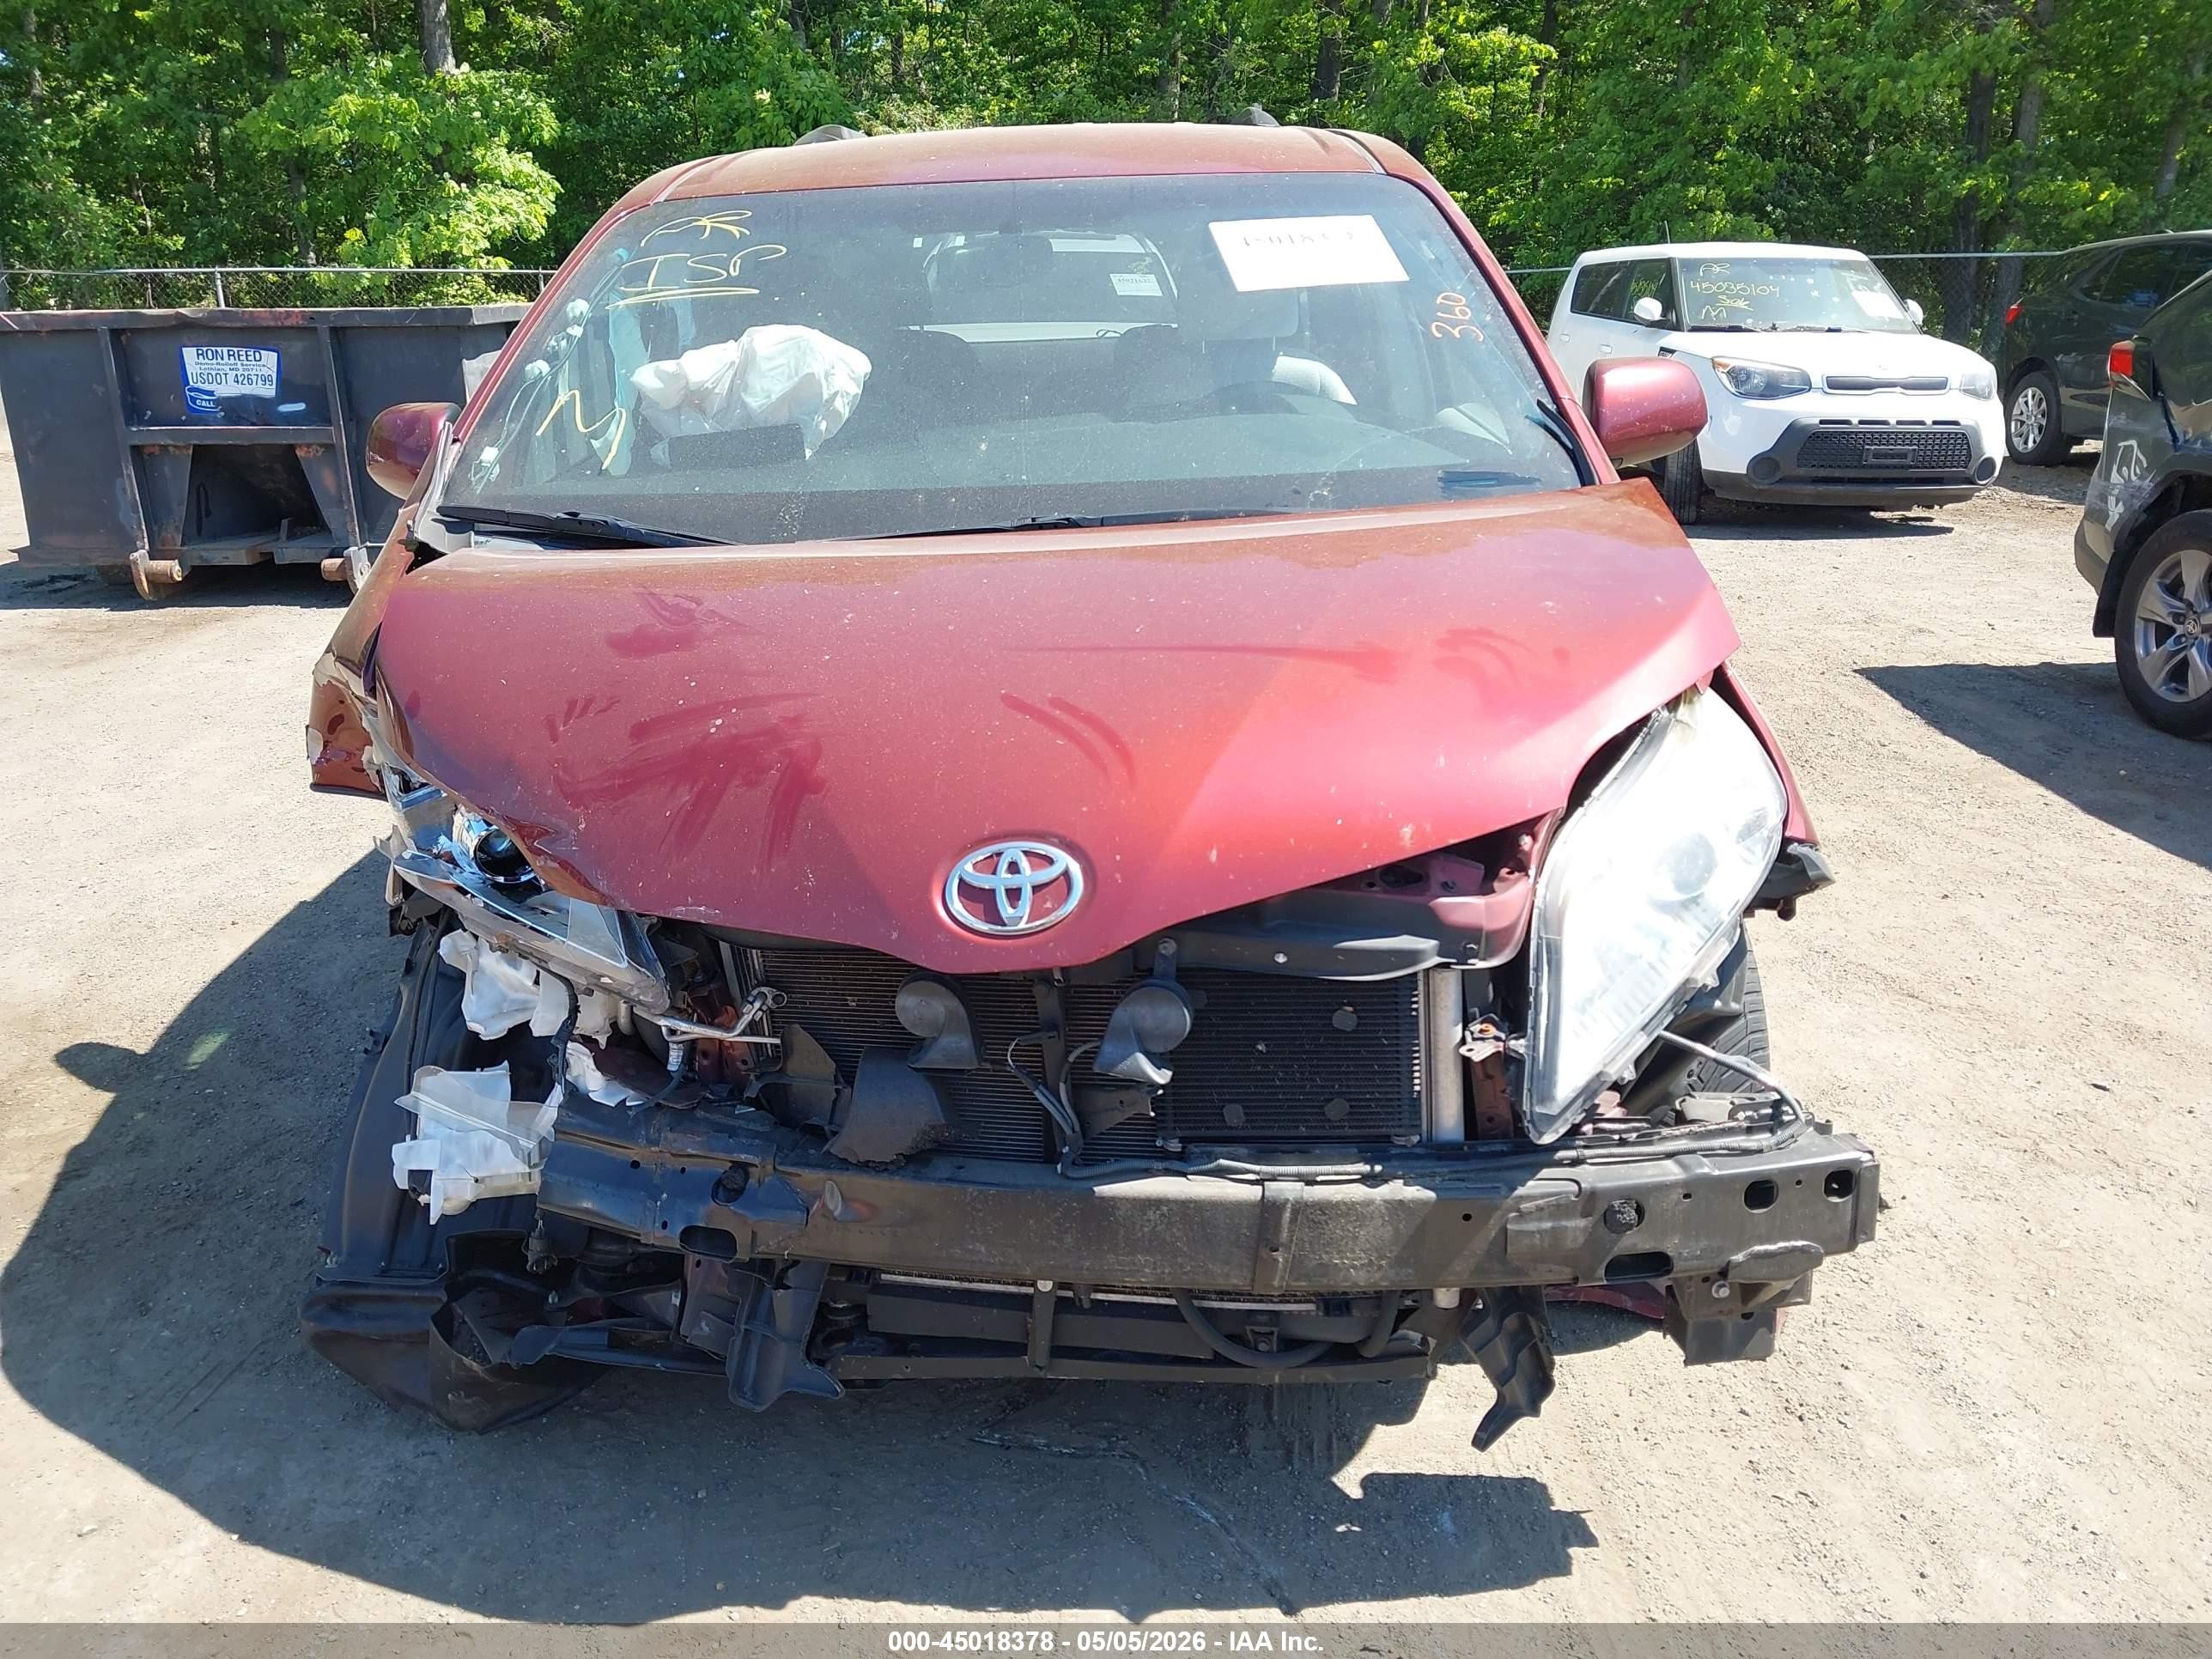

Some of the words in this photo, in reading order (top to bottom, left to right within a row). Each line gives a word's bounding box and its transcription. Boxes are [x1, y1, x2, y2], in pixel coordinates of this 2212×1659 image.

[1690, 280, 1780, 298] 45035104
[196, 348, 224, 361] RON
[228, 349, 263, 362] REED
[191, 372, 229, 385] USDOT
[233, 373, 274, 386] 426799
